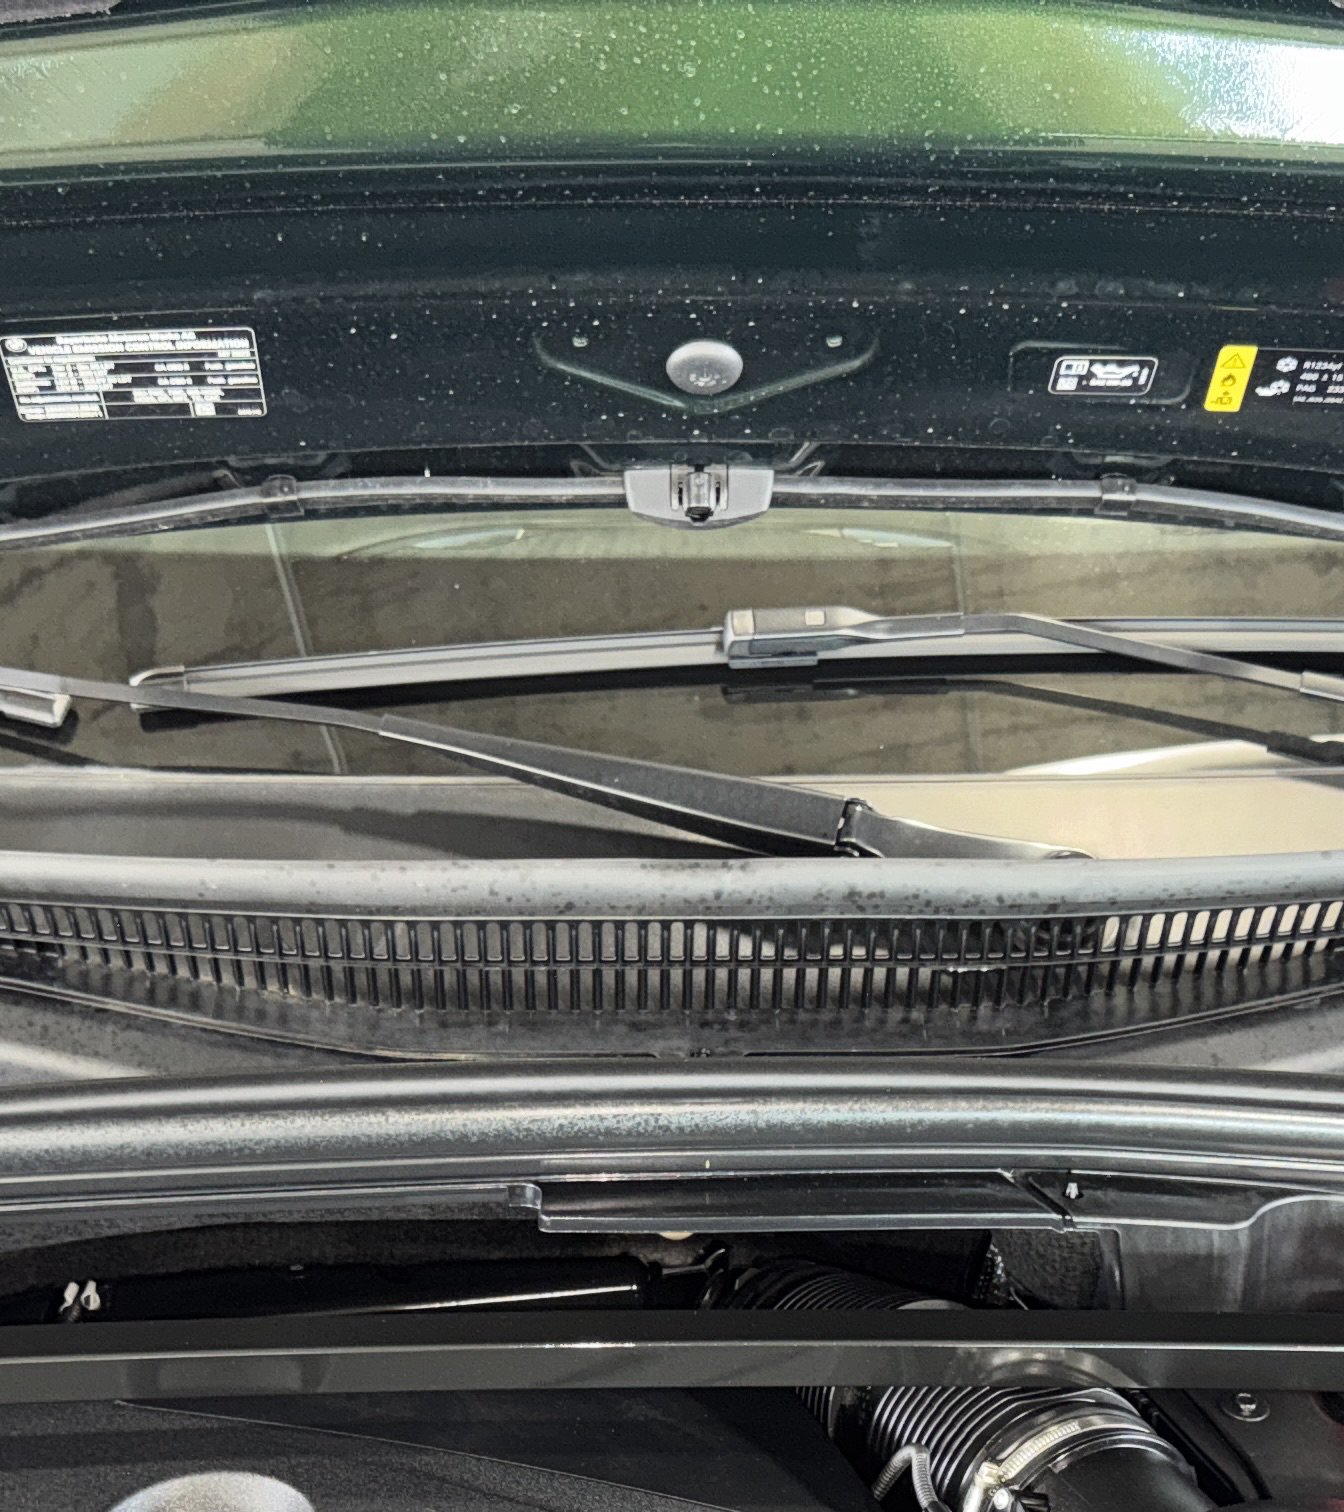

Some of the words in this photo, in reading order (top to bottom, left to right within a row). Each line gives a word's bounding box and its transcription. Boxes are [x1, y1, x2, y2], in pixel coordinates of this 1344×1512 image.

[72, 342, 124, 354] EMISSION
[125, 340, 175, 352] CONTROL
[175, 338, 250, 350] INFORMATION
